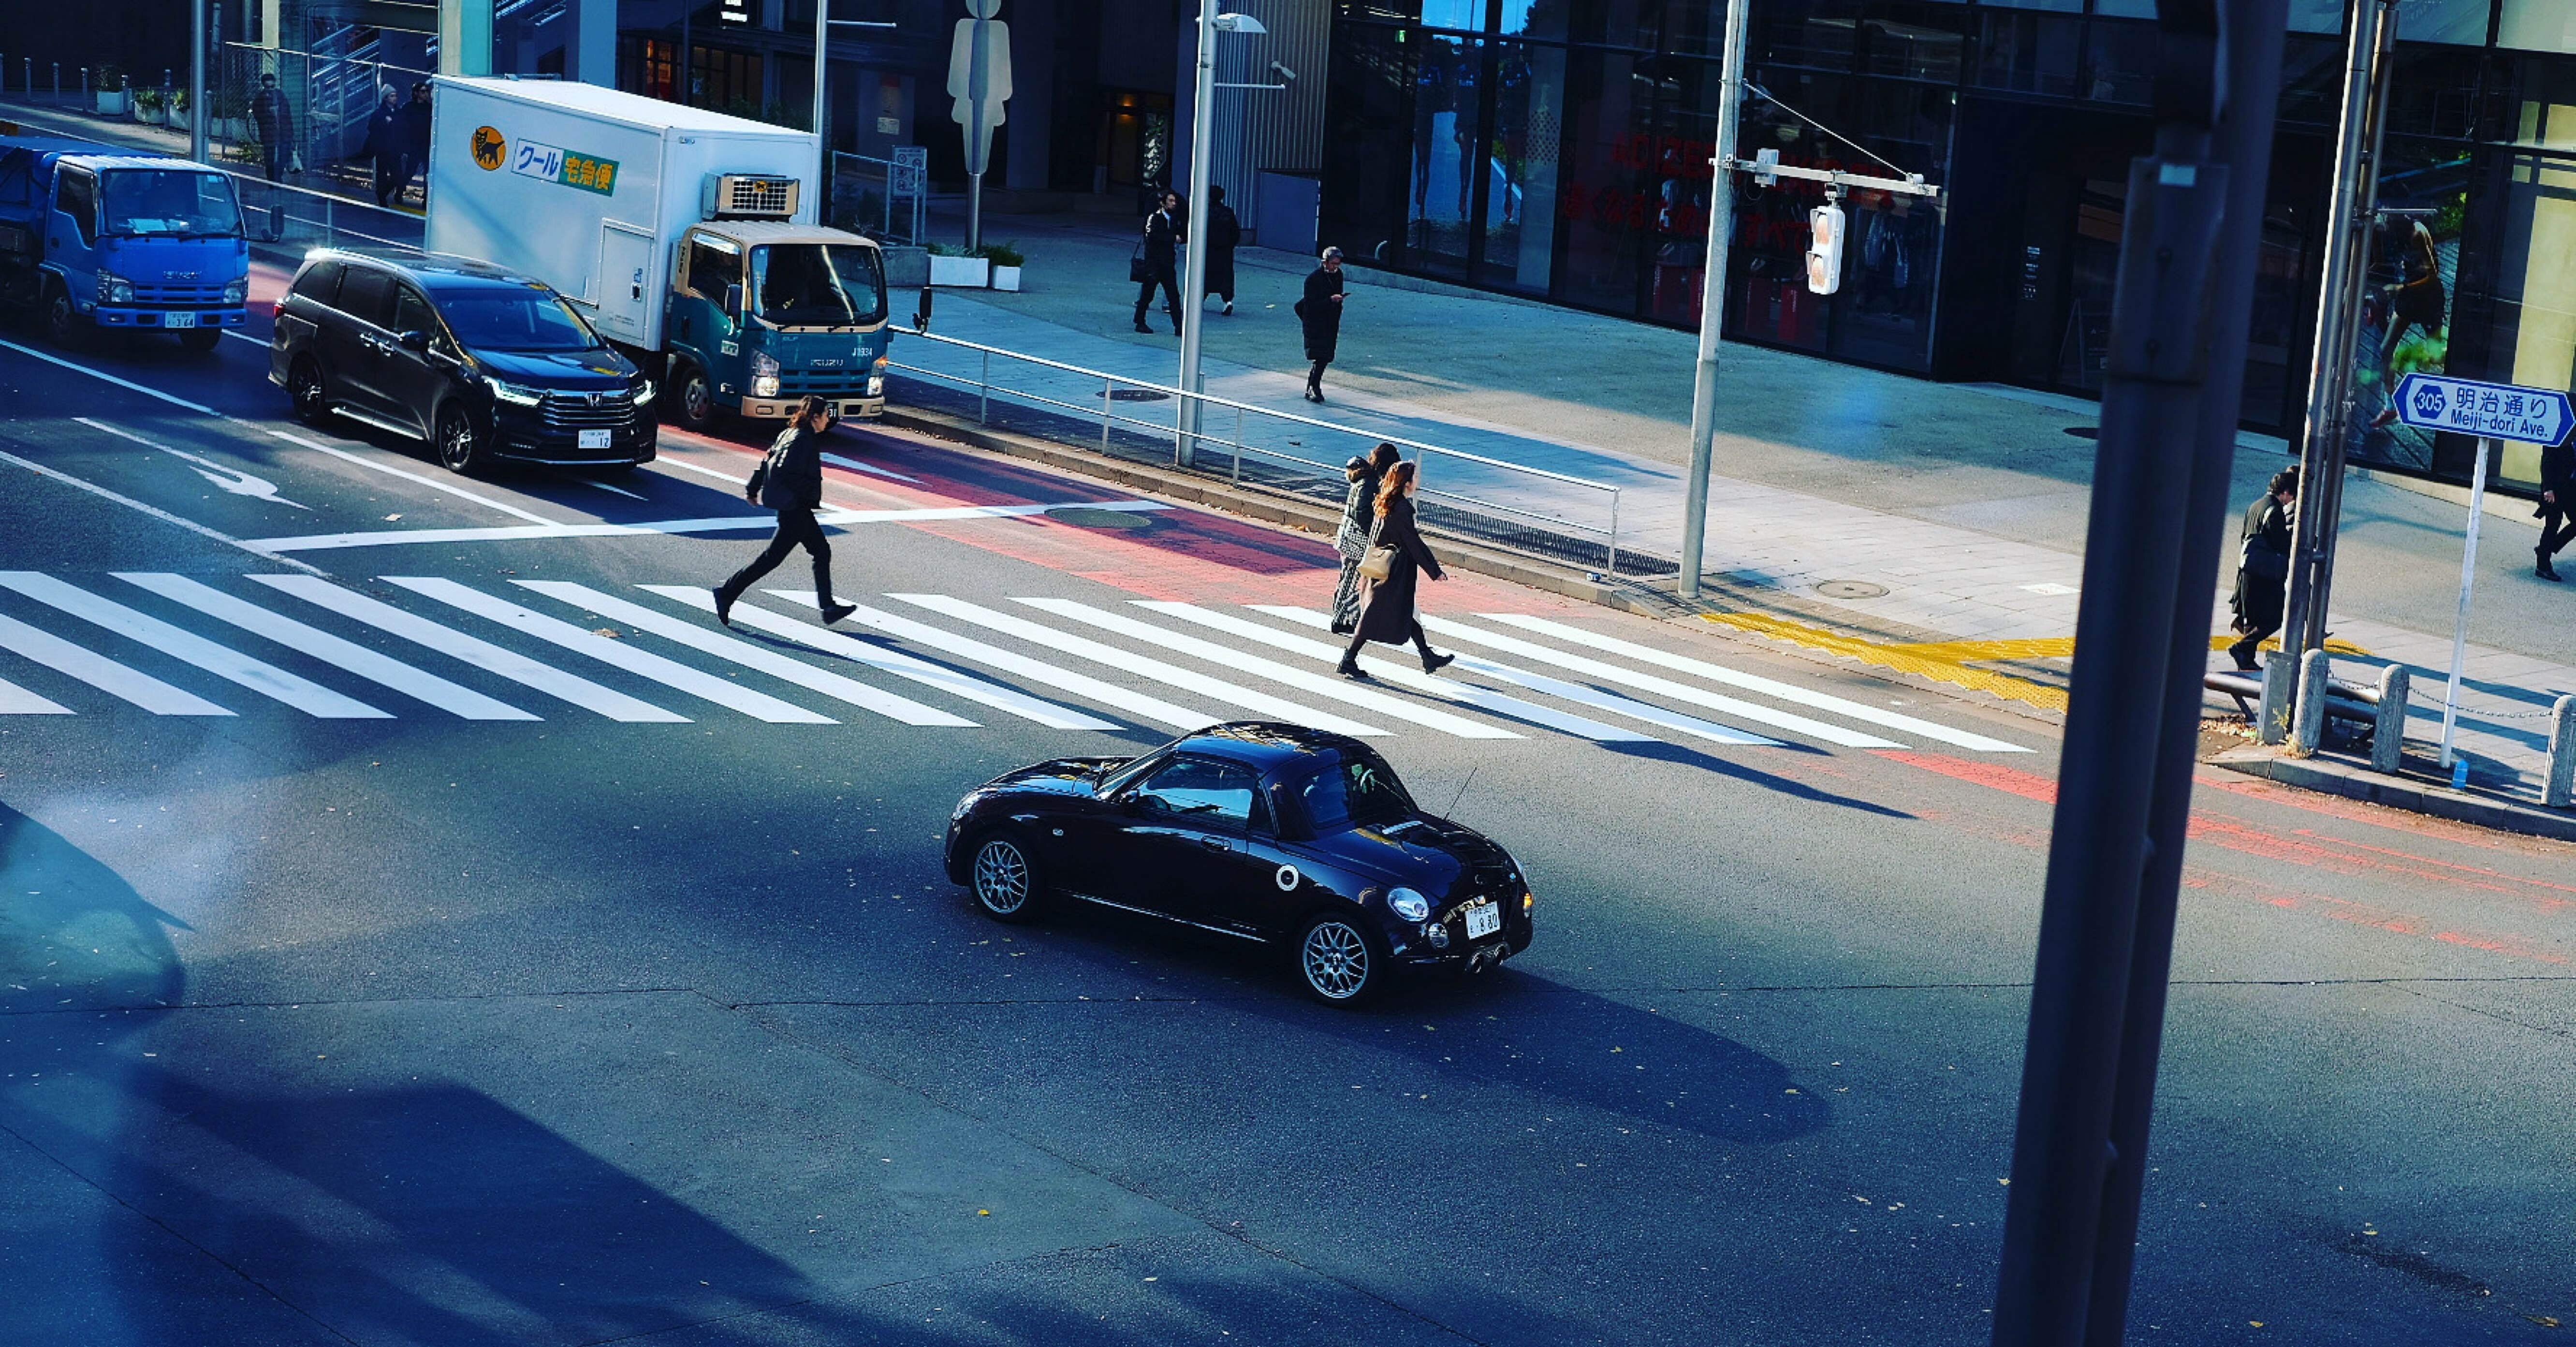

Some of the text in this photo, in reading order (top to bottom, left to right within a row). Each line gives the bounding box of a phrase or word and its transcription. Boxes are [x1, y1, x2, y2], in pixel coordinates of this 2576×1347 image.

[2417, 392, 2443, 412] 305
[2457, 387, 2547, 419] 明治通り
[2451, 409, 2548, 437] Meiji-dori Ave.
